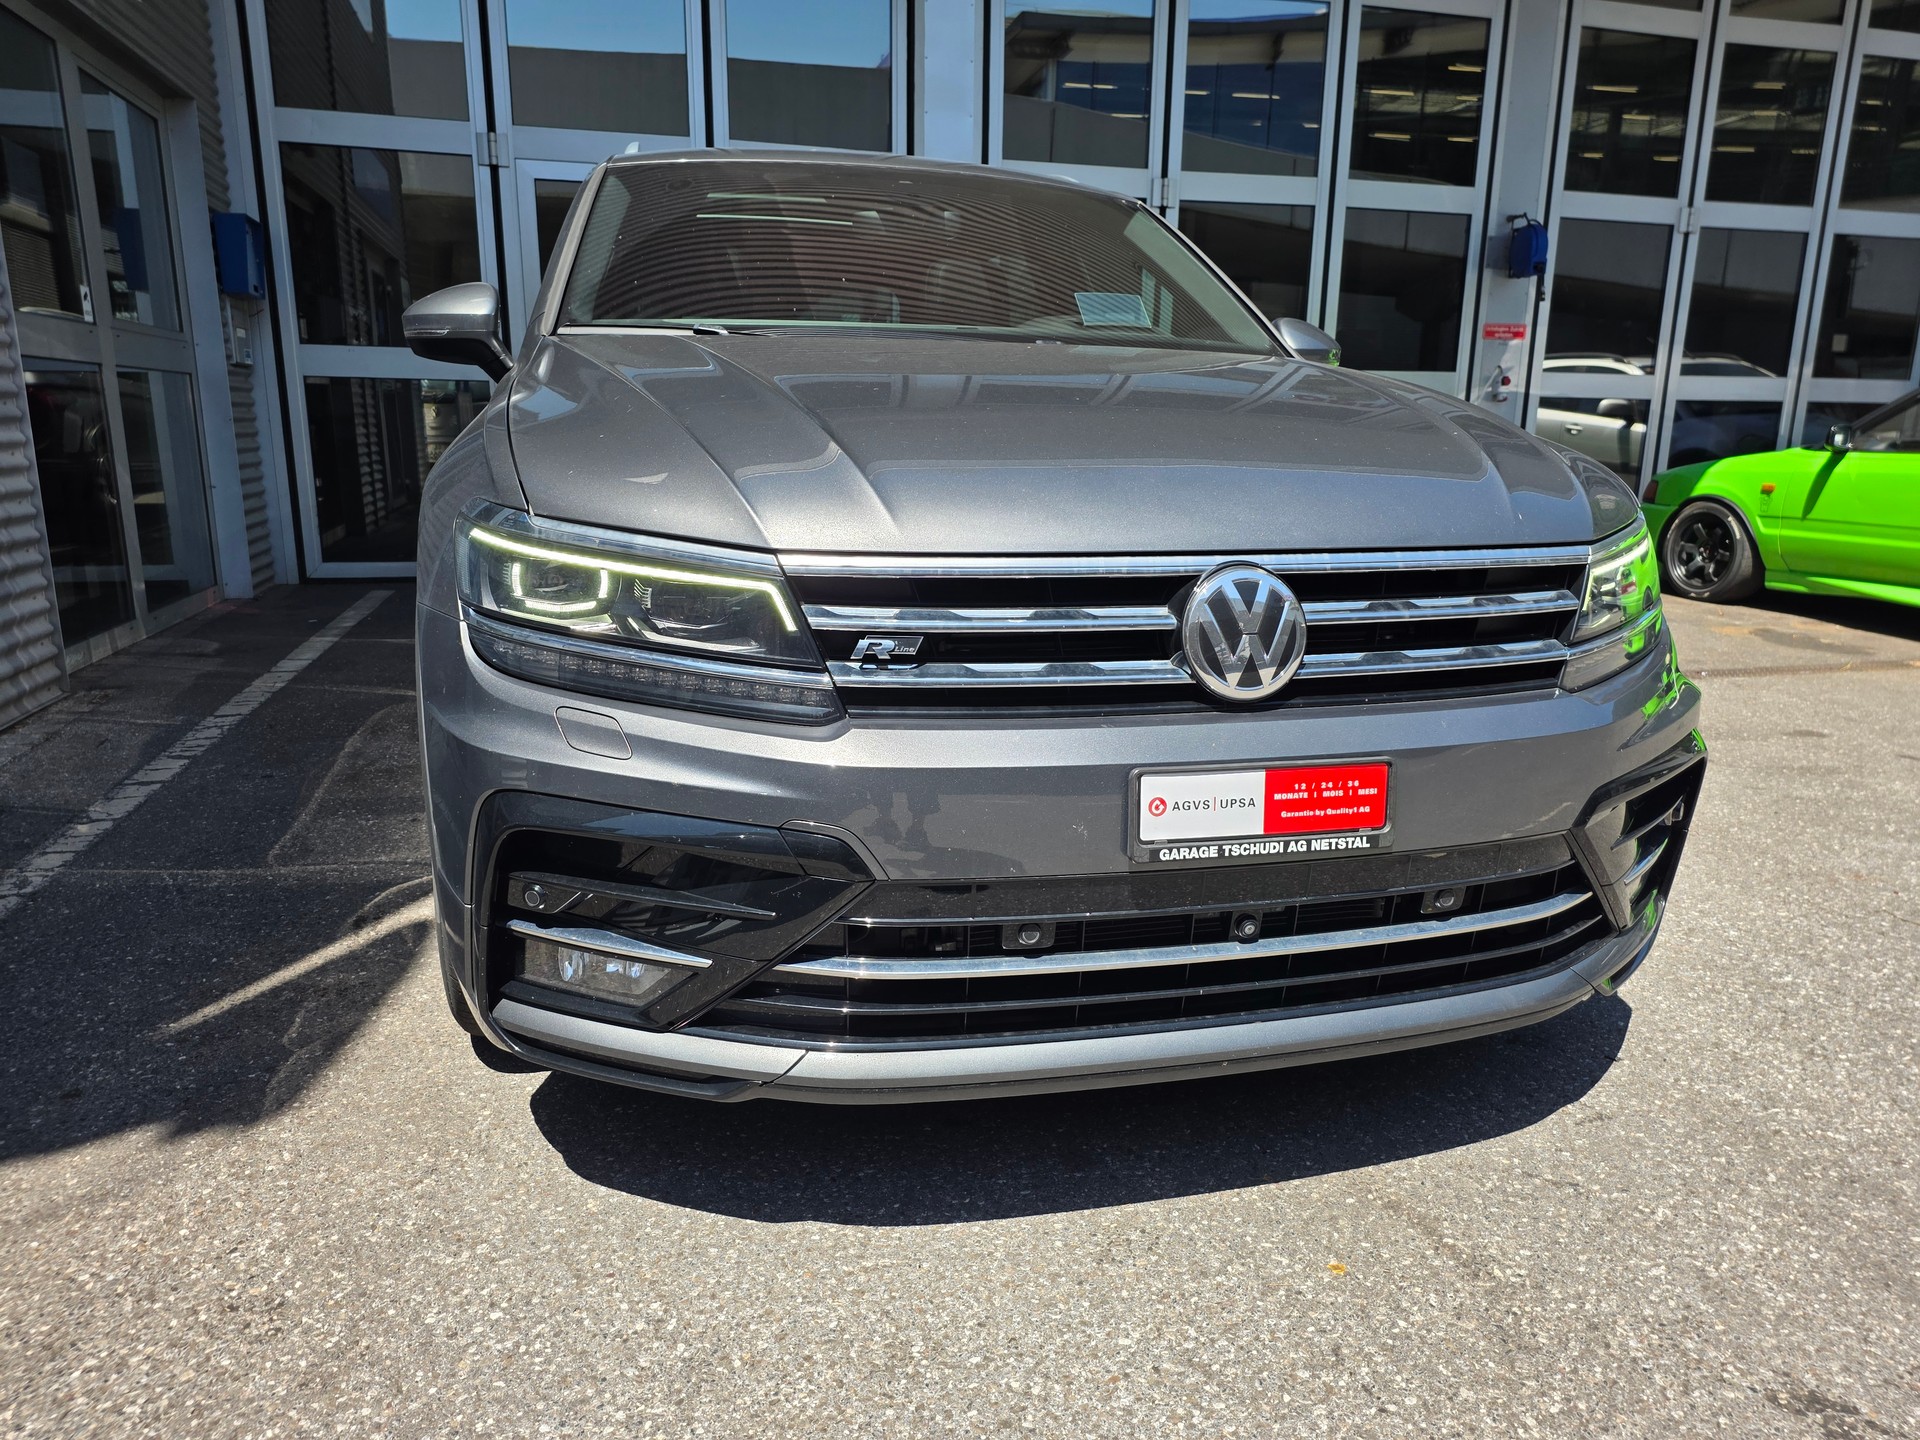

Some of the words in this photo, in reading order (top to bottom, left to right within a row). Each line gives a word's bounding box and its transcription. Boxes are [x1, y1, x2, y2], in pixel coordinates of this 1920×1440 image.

[1185, 566, 1304, 699] VW
[850, 639, 896, 660] R
[1274, 792, 1308, 800] MONATE
[1322, 789, 1344, 798] MOIS
[1171, 799, 1211, 812] AGVS
[1220, 797, 1256, 810] UPSA
[1315, 808, 1325, 817] by
[1326, 806, 1357, 816] Quality1
[1159, 845, 1219, 861] GARAGE
[1223, 842, 1284, 856] TSCHUDI
[1287, 840, 1307, 852] AG
[1310, 836, 1371, 851] NETSTAL
